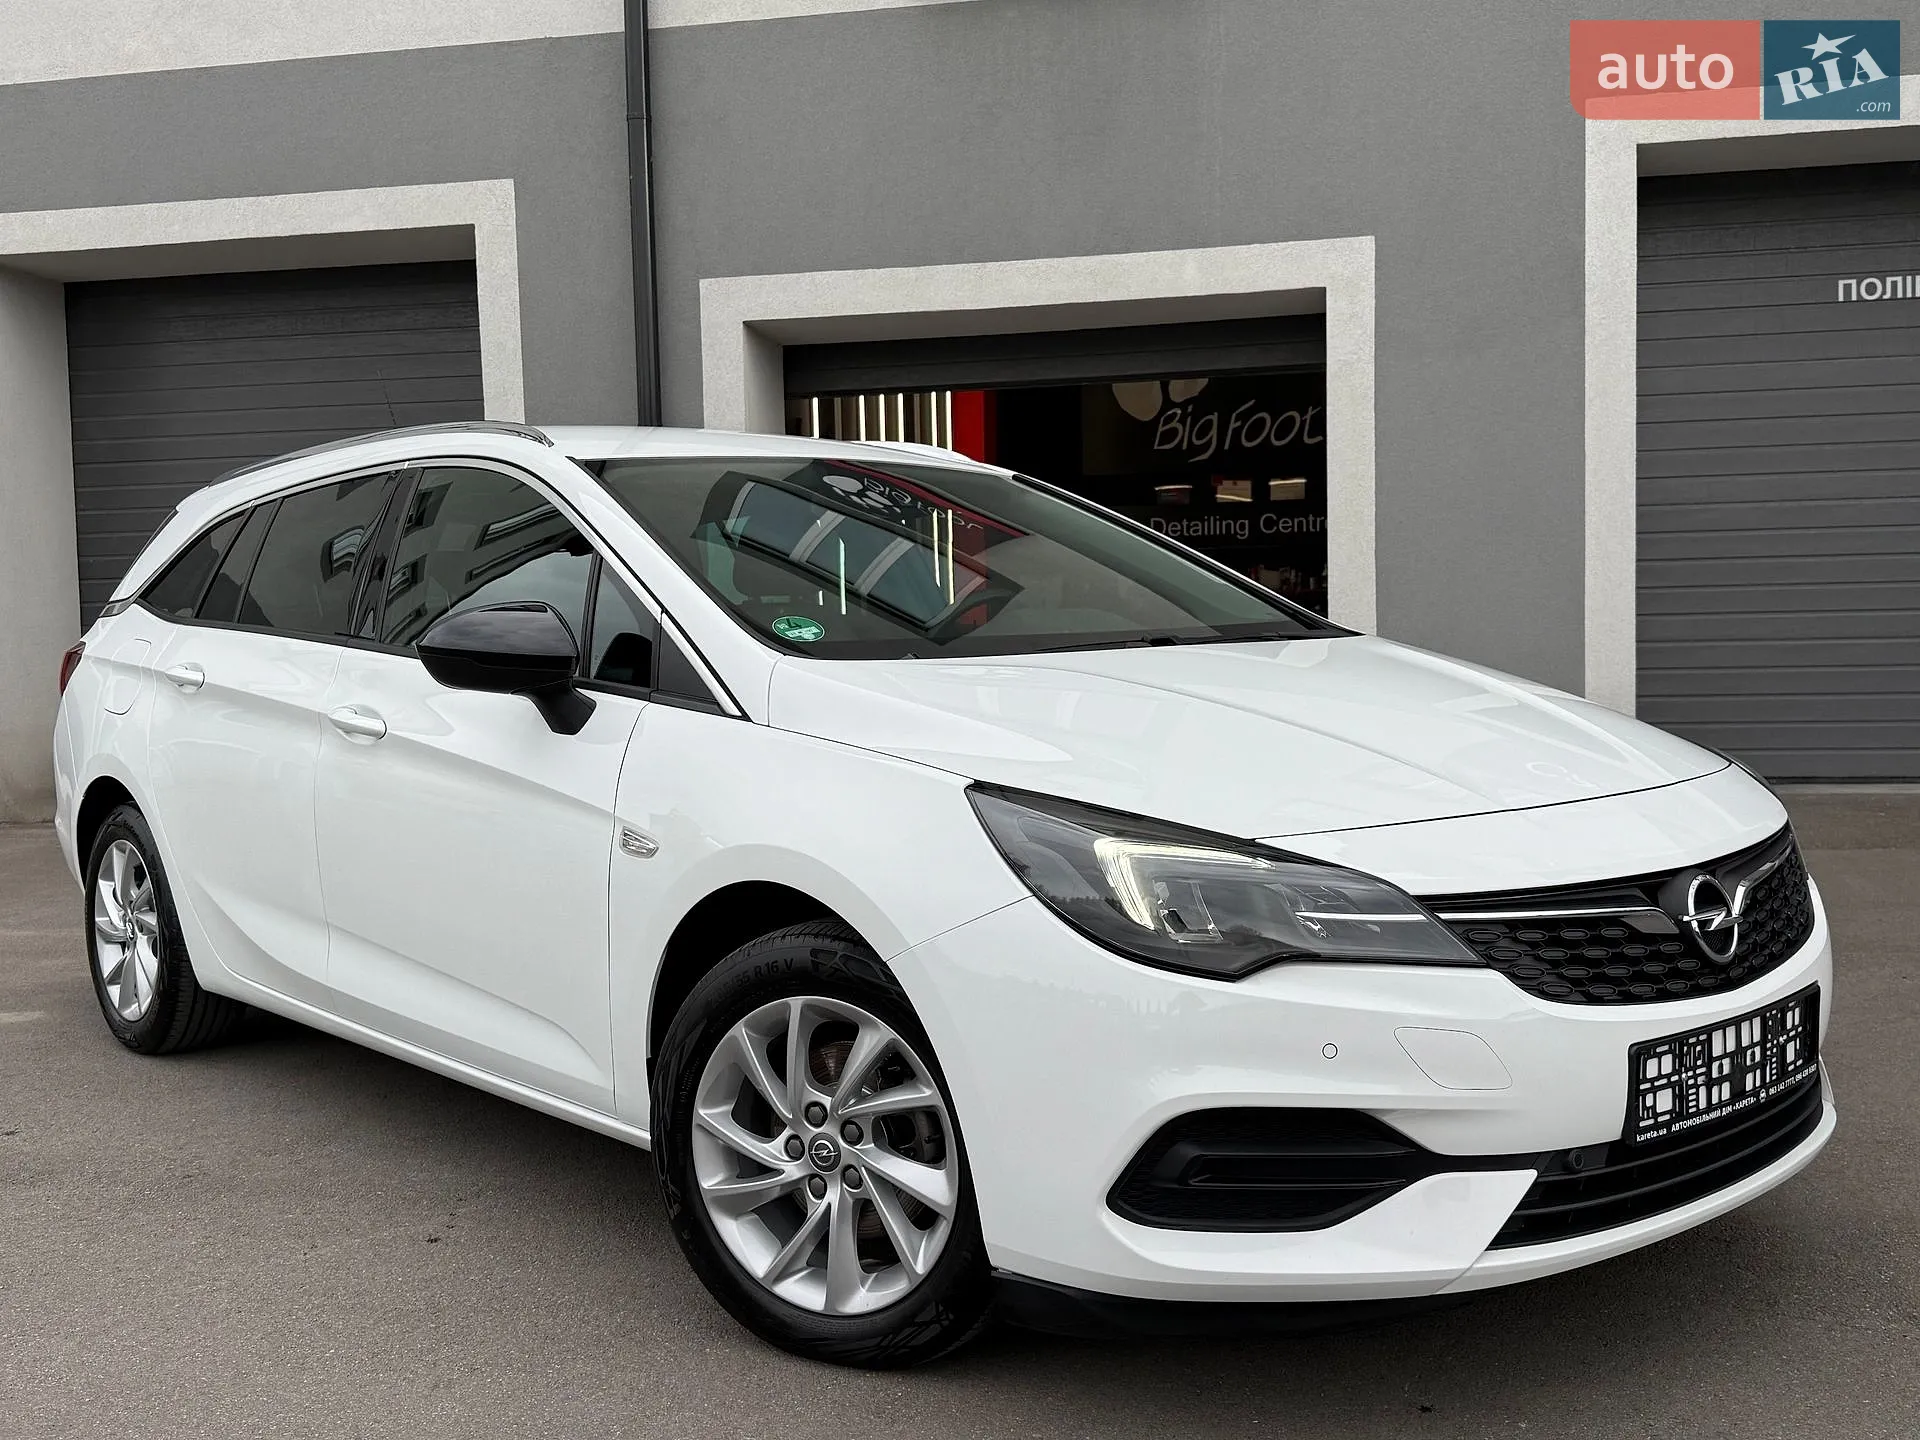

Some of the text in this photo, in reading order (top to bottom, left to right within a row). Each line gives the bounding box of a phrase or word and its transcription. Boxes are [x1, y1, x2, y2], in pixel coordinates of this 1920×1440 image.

[1150, 513, 1327, 540] Detailing Centr
[783, 957, 794, 971] V
[1636, 1127, 1667, 1142] kareta.ua
[1671, 1107, 1721, 1132] АВТОМОБІЛЬНИЙ
